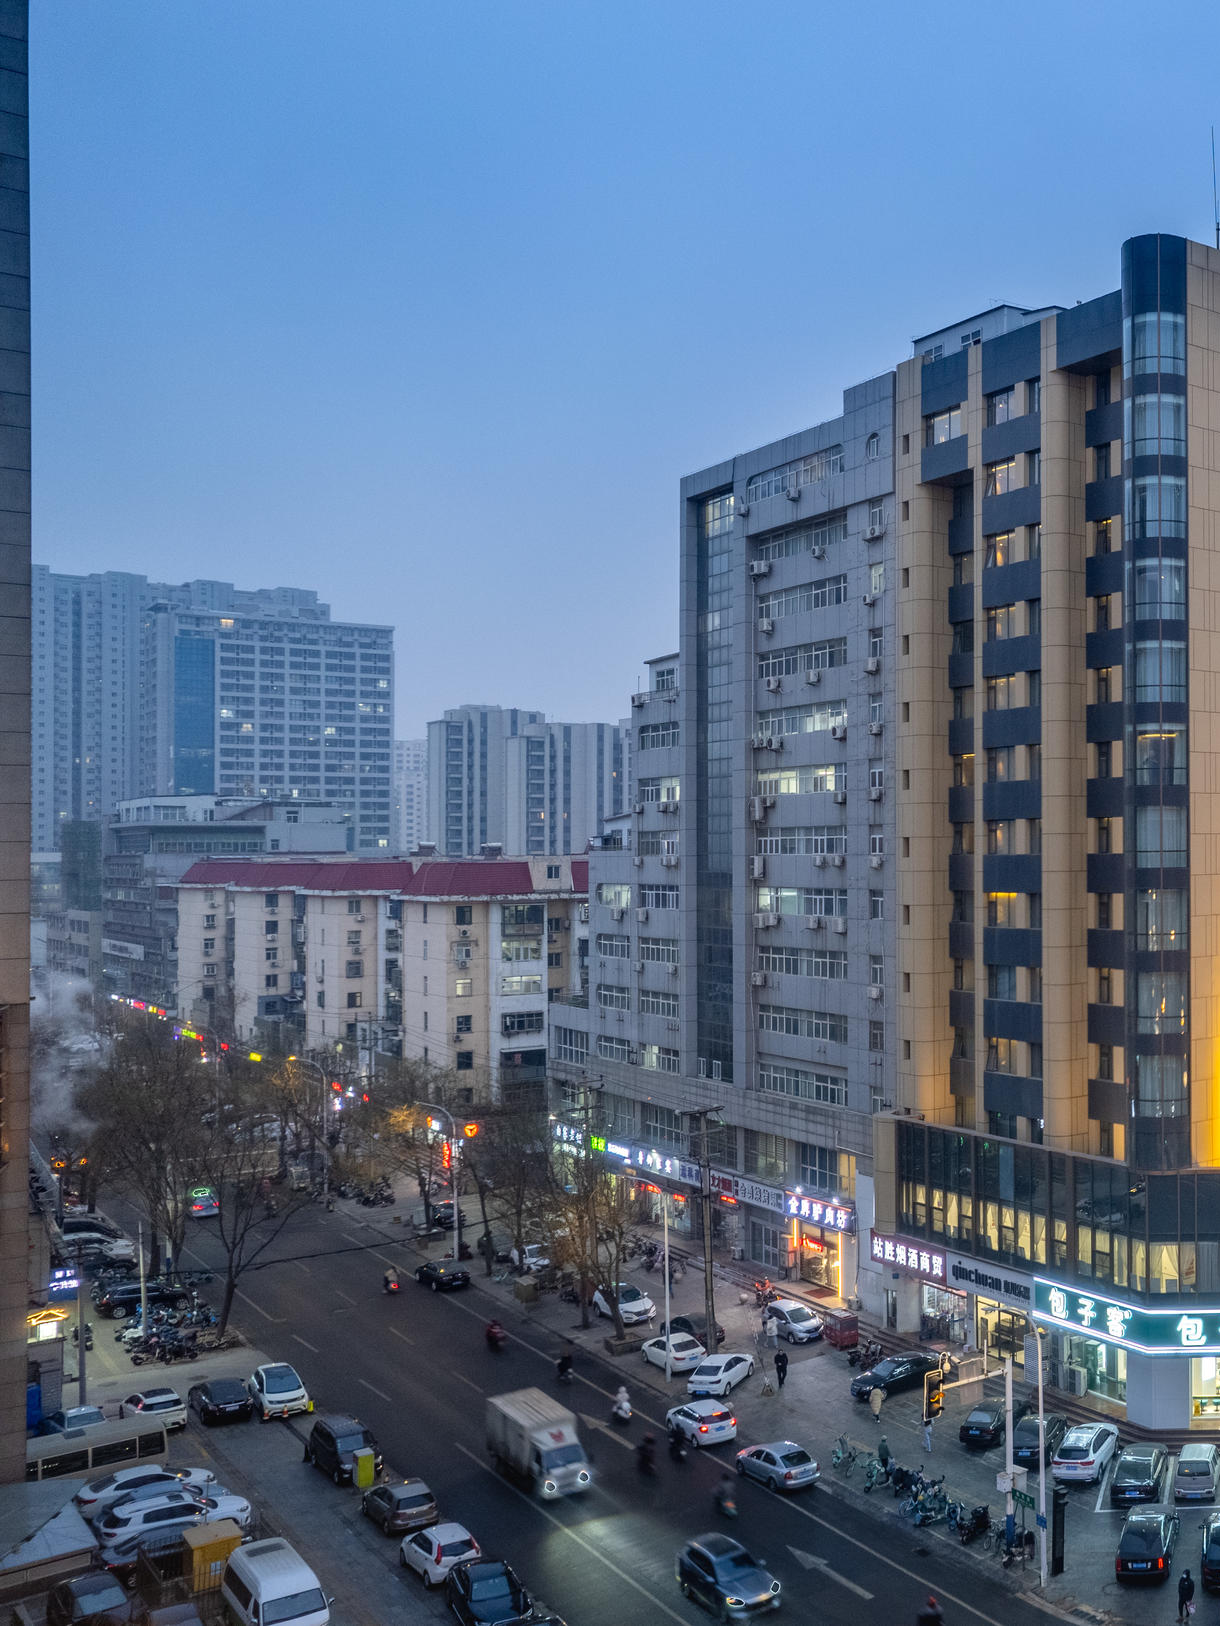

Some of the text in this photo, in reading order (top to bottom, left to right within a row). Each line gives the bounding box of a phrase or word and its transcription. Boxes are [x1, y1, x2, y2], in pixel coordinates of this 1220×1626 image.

[872, 1236, 943, 1278] 站胜烟酒商贸
[951, 1260, 1002, 1292] qinchuan
[1048, 1287, 1129, 1338] 包子客
